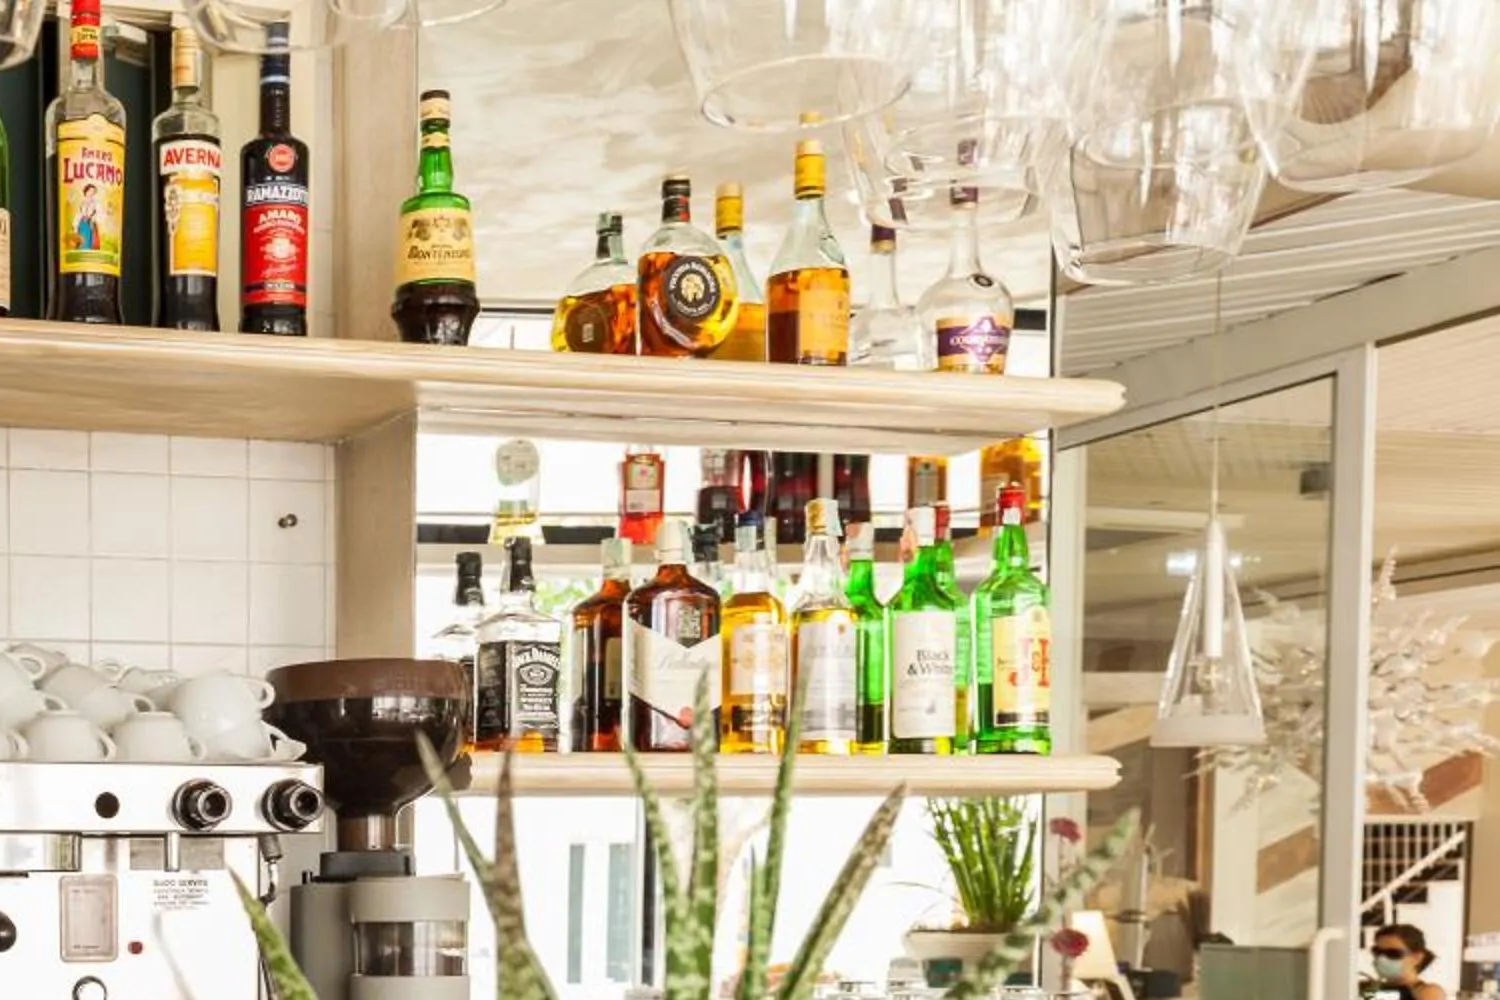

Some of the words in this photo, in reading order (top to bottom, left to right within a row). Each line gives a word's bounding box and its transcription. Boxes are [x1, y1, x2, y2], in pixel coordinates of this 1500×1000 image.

[63, 157, 123, 187] LUCANO
[259, 210, 301, 226] AMARO
[916, 650, 949, 661] Black
[906, 664, 917, 675] &
